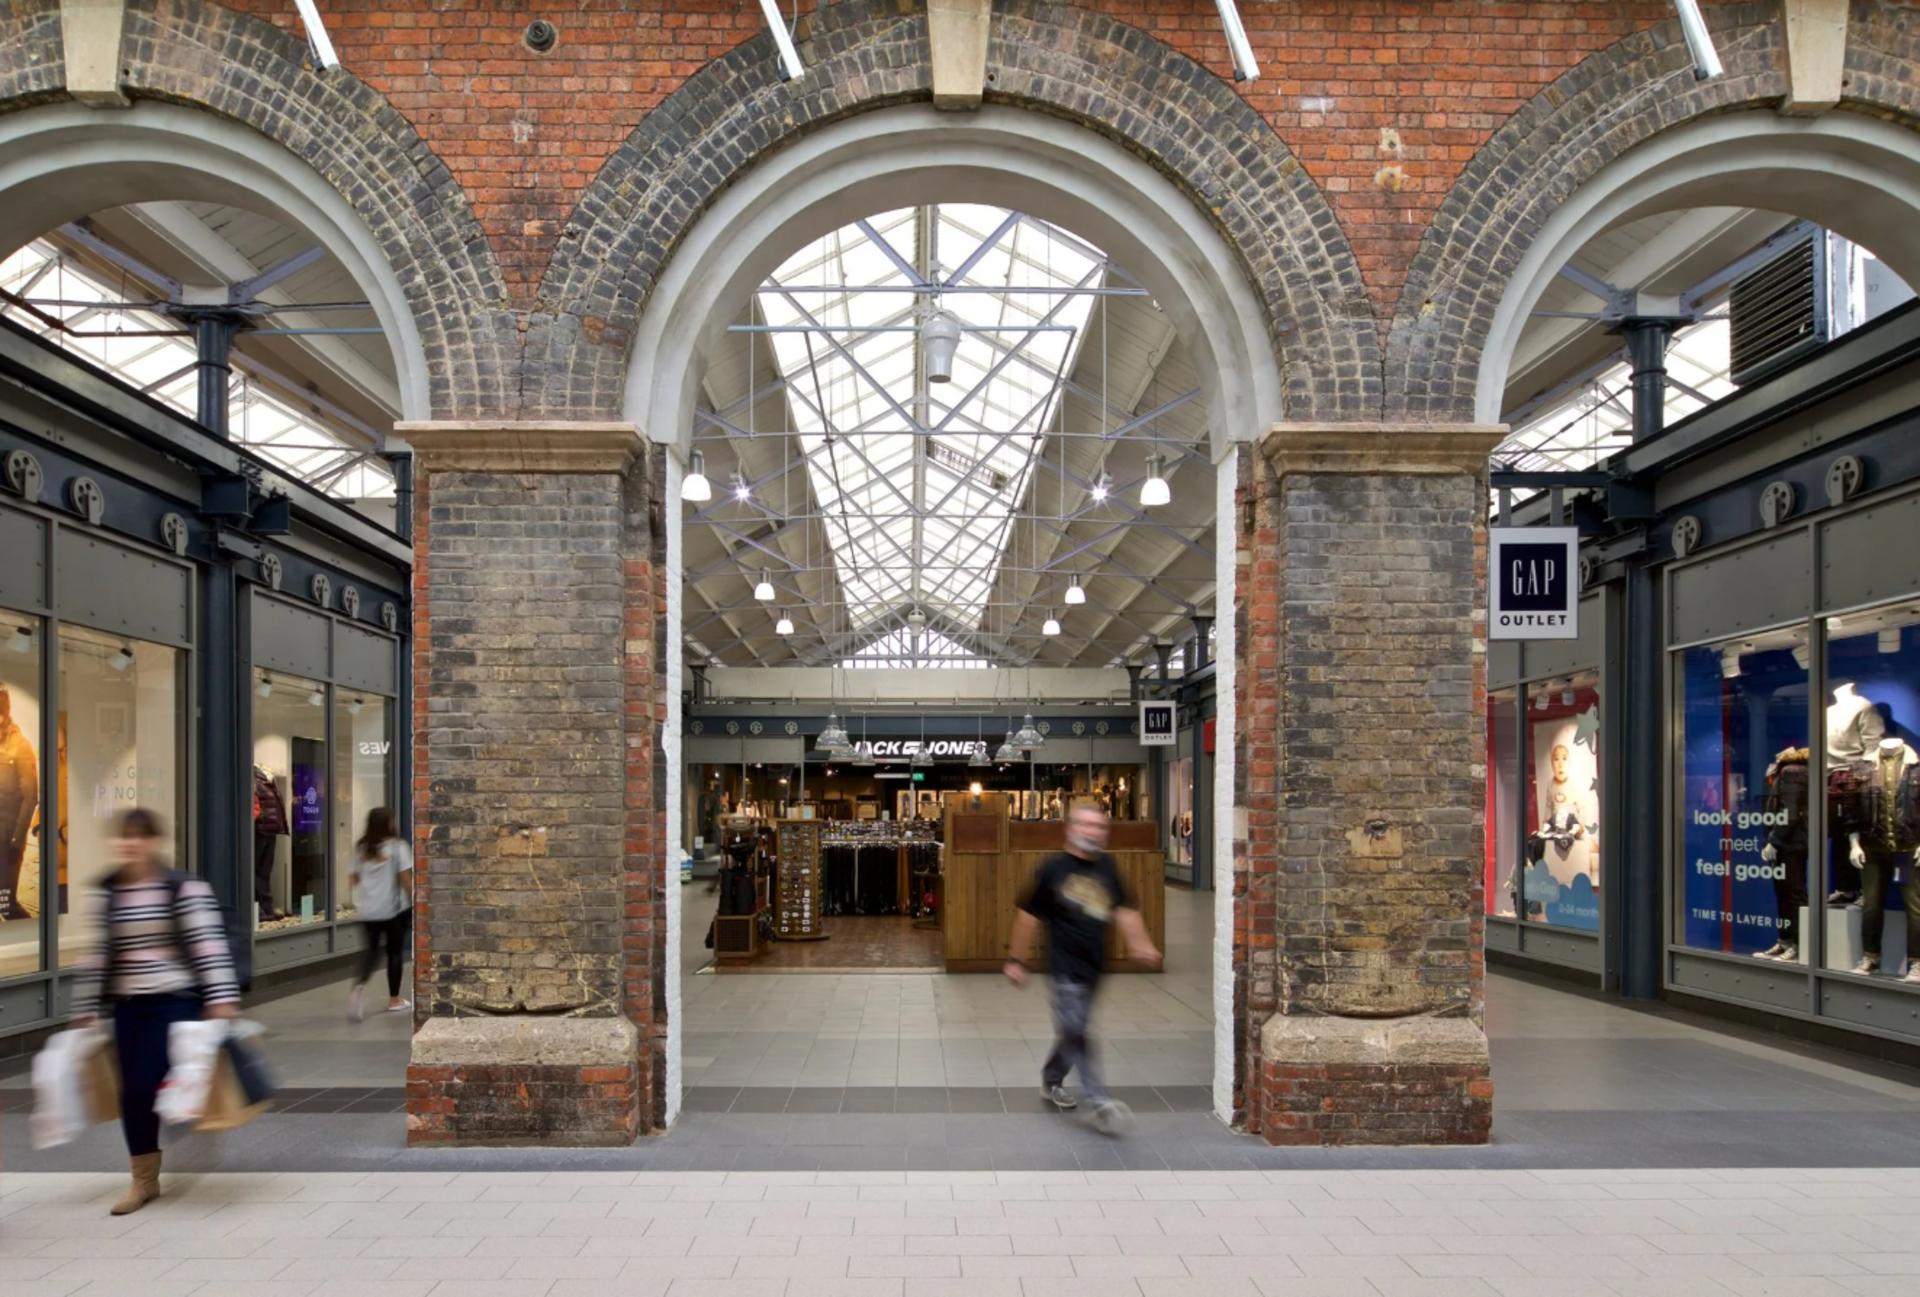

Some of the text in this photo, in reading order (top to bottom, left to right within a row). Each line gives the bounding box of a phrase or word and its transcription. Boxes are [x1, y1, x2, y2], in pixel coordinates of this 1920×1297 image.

[1512, 559, 1556, 596] GAP
[1500, 615, 1567, 626] OUTLET
[1148, 712, 1168, 728] GAP
[926, 741, 988, 755] JONES
[1694, 808, 1789, 829] look good
[1719, 836, 1759, 852] meet
[1696, 858, 1787, 881] feel good
[1691, 907, 1792, 929] TIME TO LAYER UP
